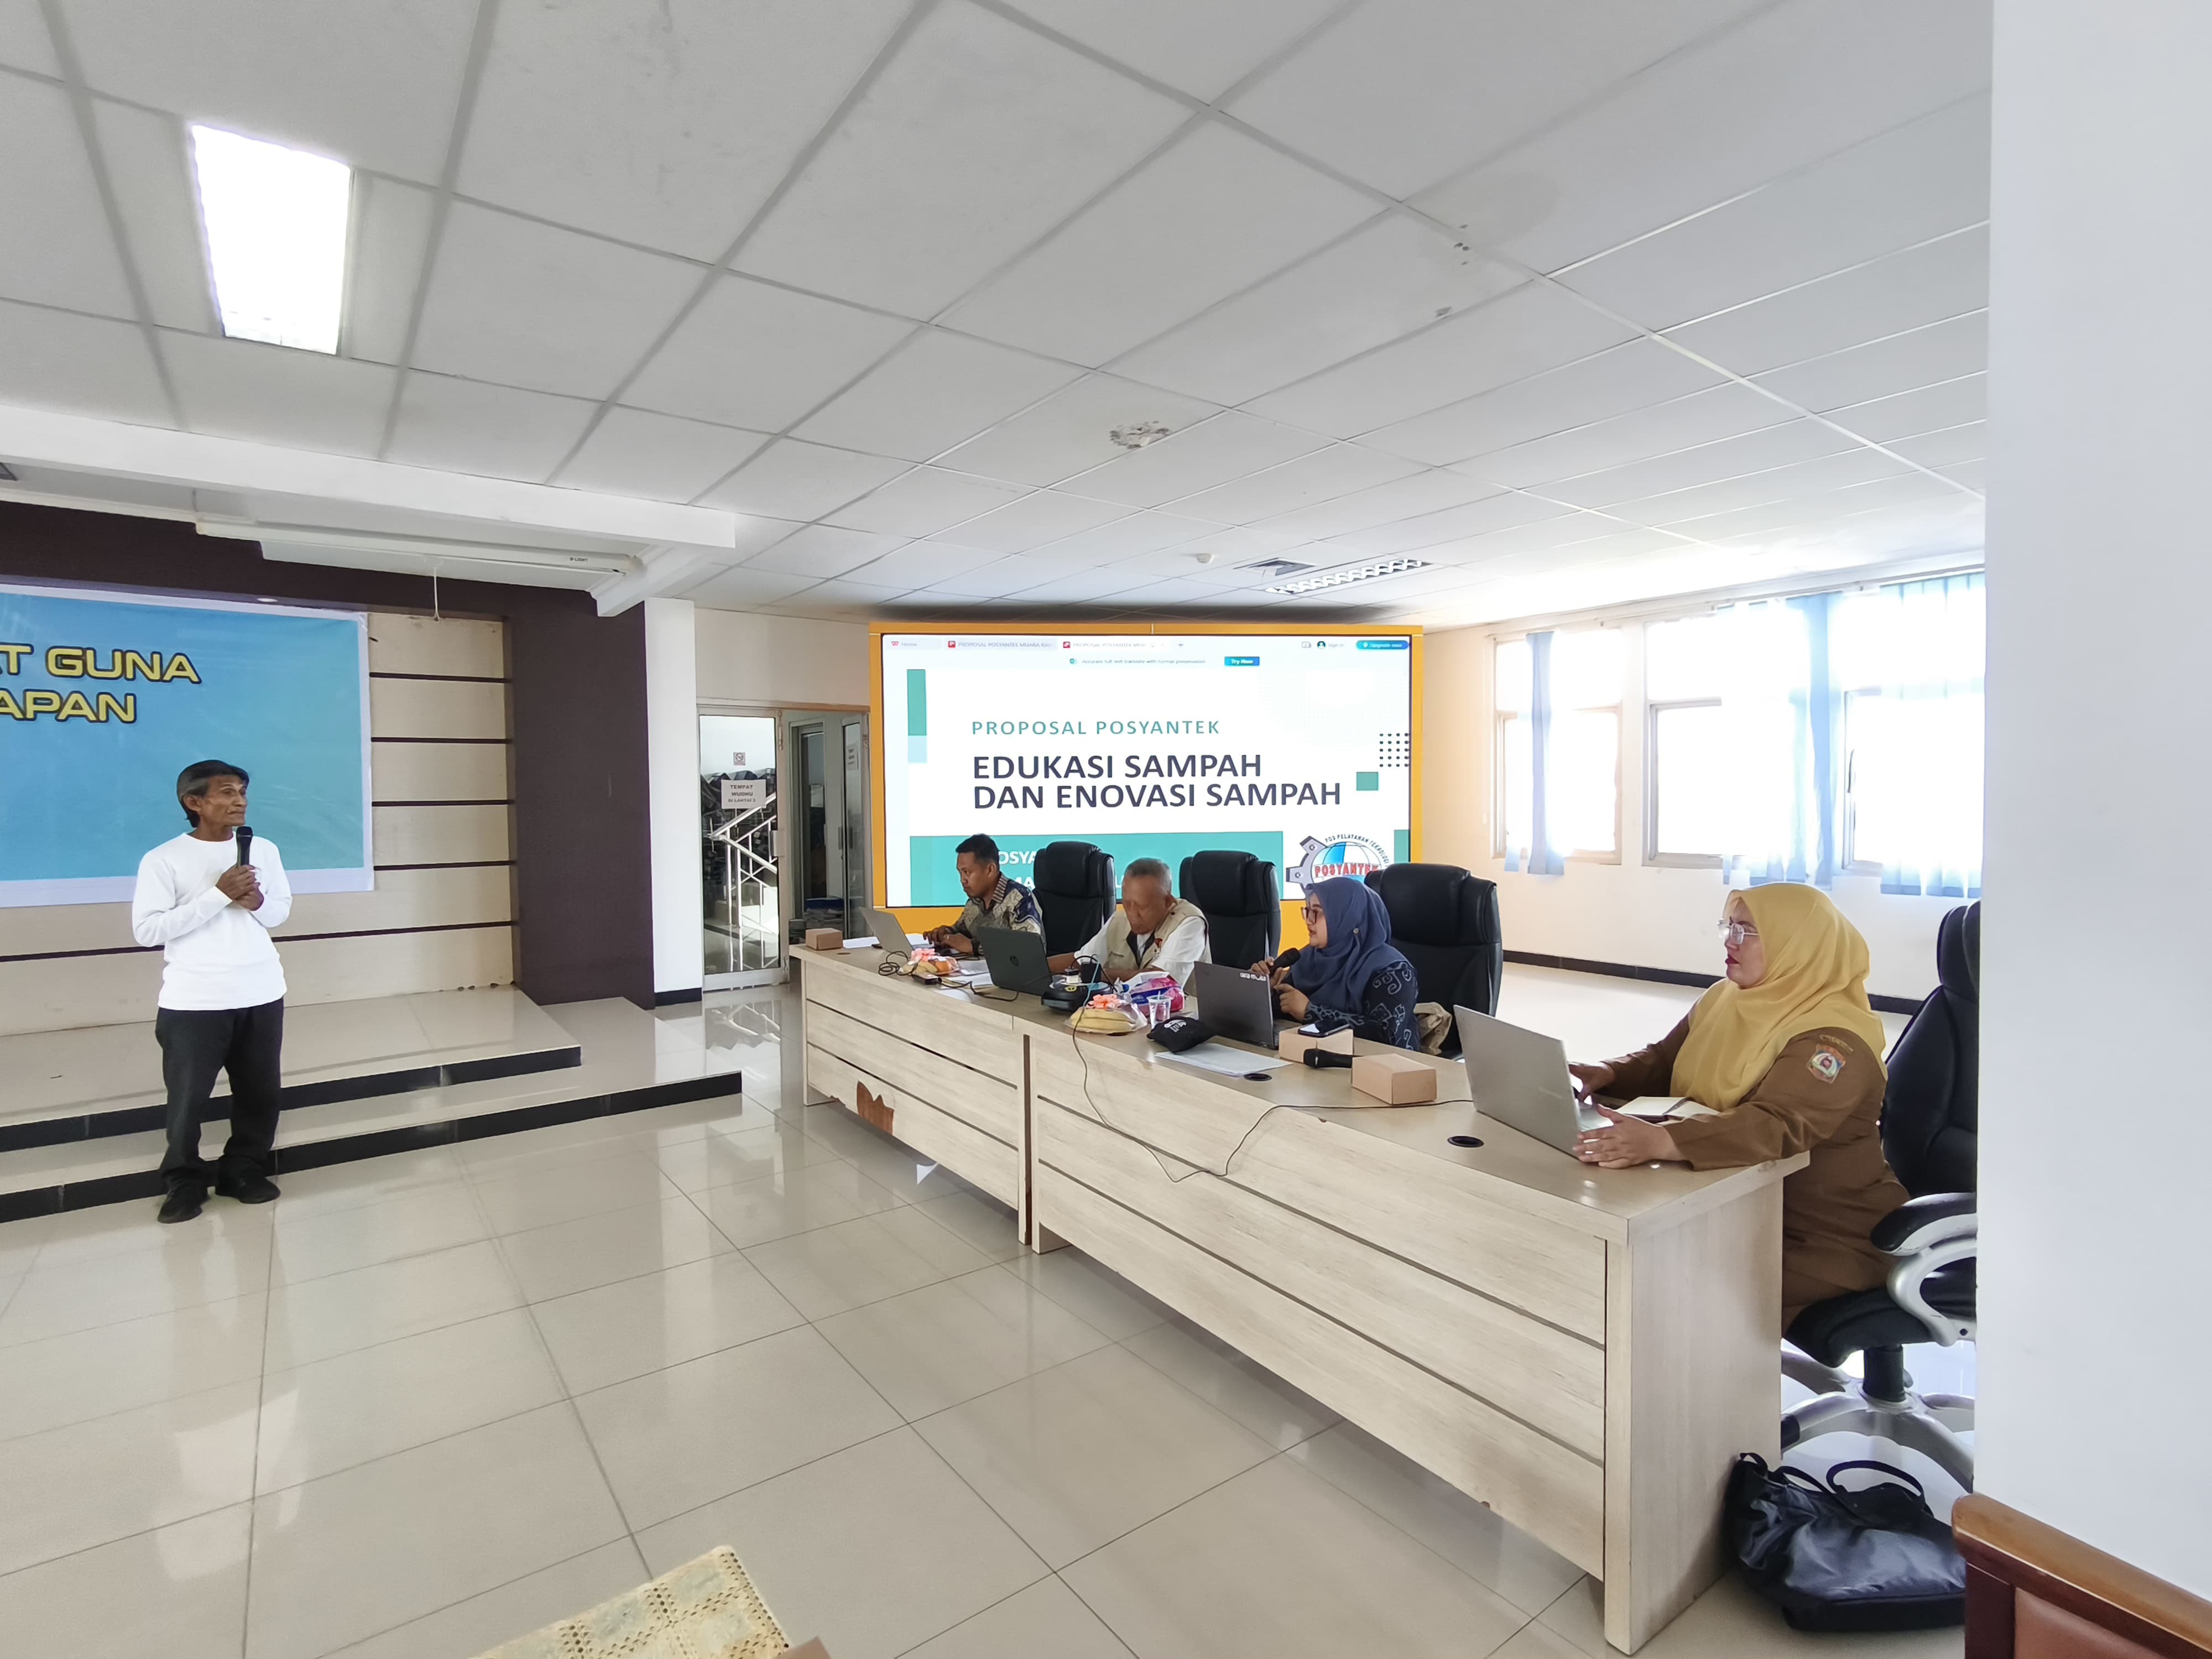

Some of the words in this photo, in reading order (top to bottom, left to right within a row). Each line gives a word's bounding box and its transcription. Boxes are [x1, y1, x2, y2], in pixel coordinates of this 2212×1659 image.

[45, 645, 202, 685] GUNA
[972, 721, 1087, 735] PROPOSAL
[1096, 720, 1219, 734] POSYANTEK
[974, 755, 1113, 779] EDUKASI
[1125, 754, 1261, 778] SAMPAH
[974, 786, 1044, 808] DAN
[1057, 784, 1194, 808] ENOVASI
[1206, 782, 1340, 807] SAMPAH
